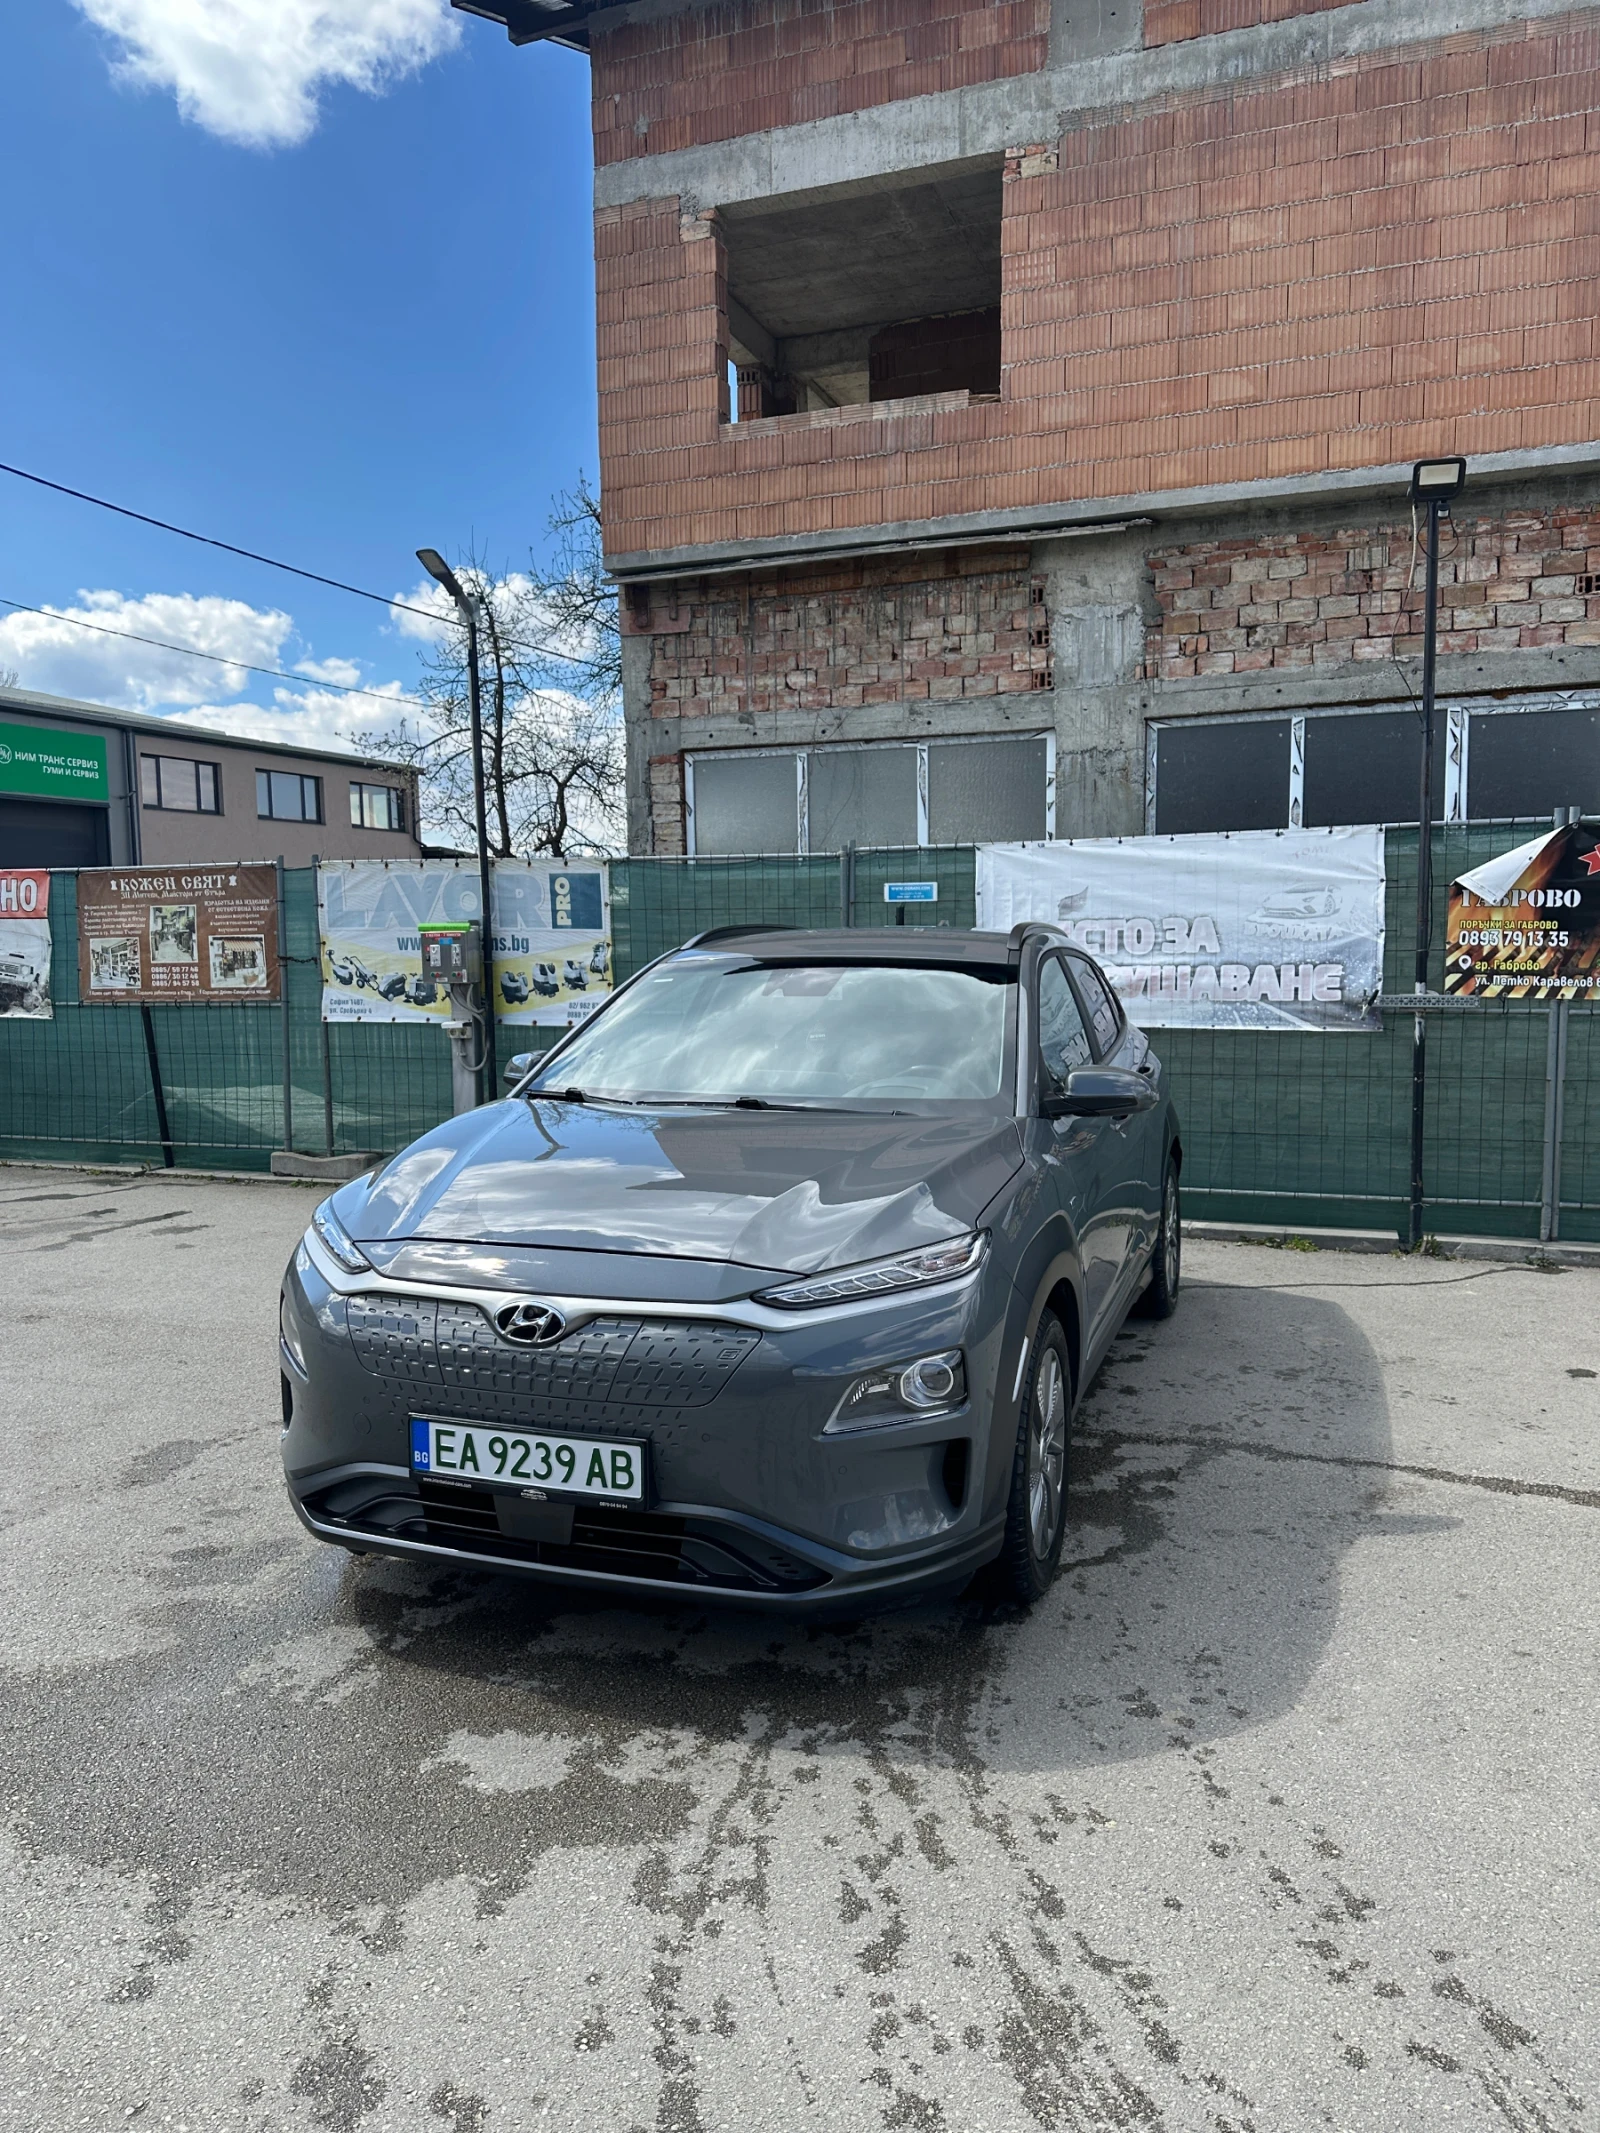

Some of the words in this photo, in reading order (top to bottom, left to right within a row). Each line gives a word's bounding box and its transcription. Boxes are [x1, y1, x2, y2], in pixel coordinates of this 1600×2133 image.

[15, 751, 36, 762] НИМ
[38, 754, 65, 765] ТРАНС
[67, 758, 98, 769] СЕРВИЗ
[43, 765, 63, 775] ГУМИ
[65, 768, 71, 776] И
[73, 769, 99, 779] СЕРВИЗ
[120, 877, 176, 891] КОЖЕН
[182, 875, 225, 889] СВЯТ
[325, 873, 549, 929] LAVOR
[554, 876, 573, 926] PRO
[1460, 921, 1502, 930] ПОРЪЧКИ
[1504, 921, 1515, 929] ЗА
[1518, 920, 1559, 929] ГАБРОВО
[1058, 918, 1155, 955] СТО
[1161, 917, 1221, 953] ЗА
[1459, 930, 1499, 946] 0893
[1503, 930, 1523, 946] 79
[1527, 930, 1544, 946] 13
[1548, 930, 1569, 947] 35
[1475, 961, 1491, 971] гр.
[1494, 960, 1540, 972] Габрово
[1475, 976, 1490, 987] ул.
[1493, 975, 1530, 986] Петко
[1533, 975, 1594, 987] Каравелов
[414, 1451, 428, 1463] BG
[435, 1428, 480, 1472] EA
[488, 1436, 576, 1484] 9239
[586, 1447, 635, 1491] AB
